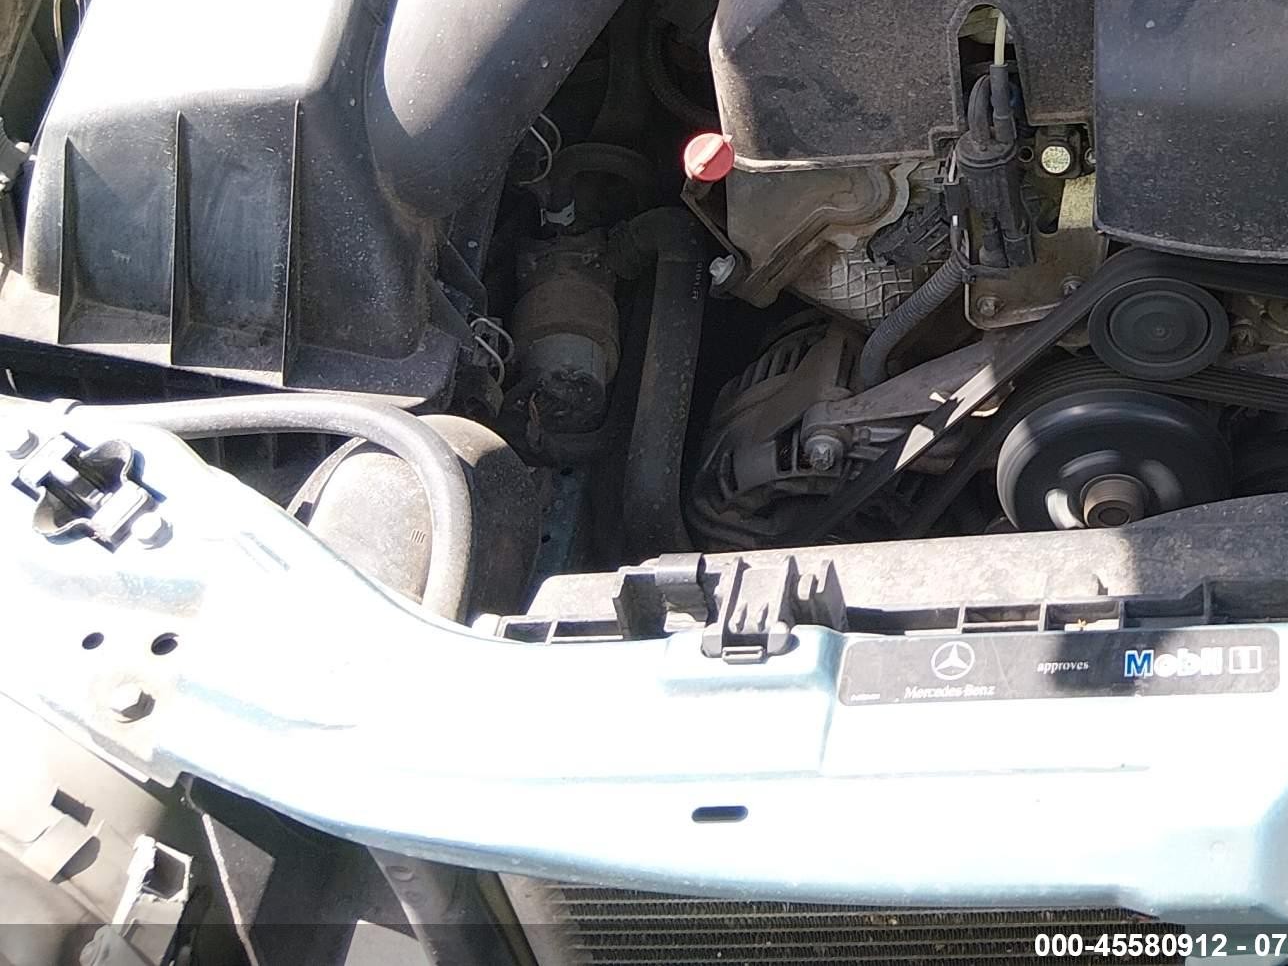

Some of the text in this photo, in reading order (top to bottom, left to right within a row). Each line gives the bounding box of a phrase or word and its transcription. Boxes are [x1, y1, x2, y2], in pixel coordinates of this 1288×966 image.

[1037, 660, 1089, 674] approves
[1124, 646, 1222, 677] Mobil
[904, 685, 996, 699] Mercedes-Benz
